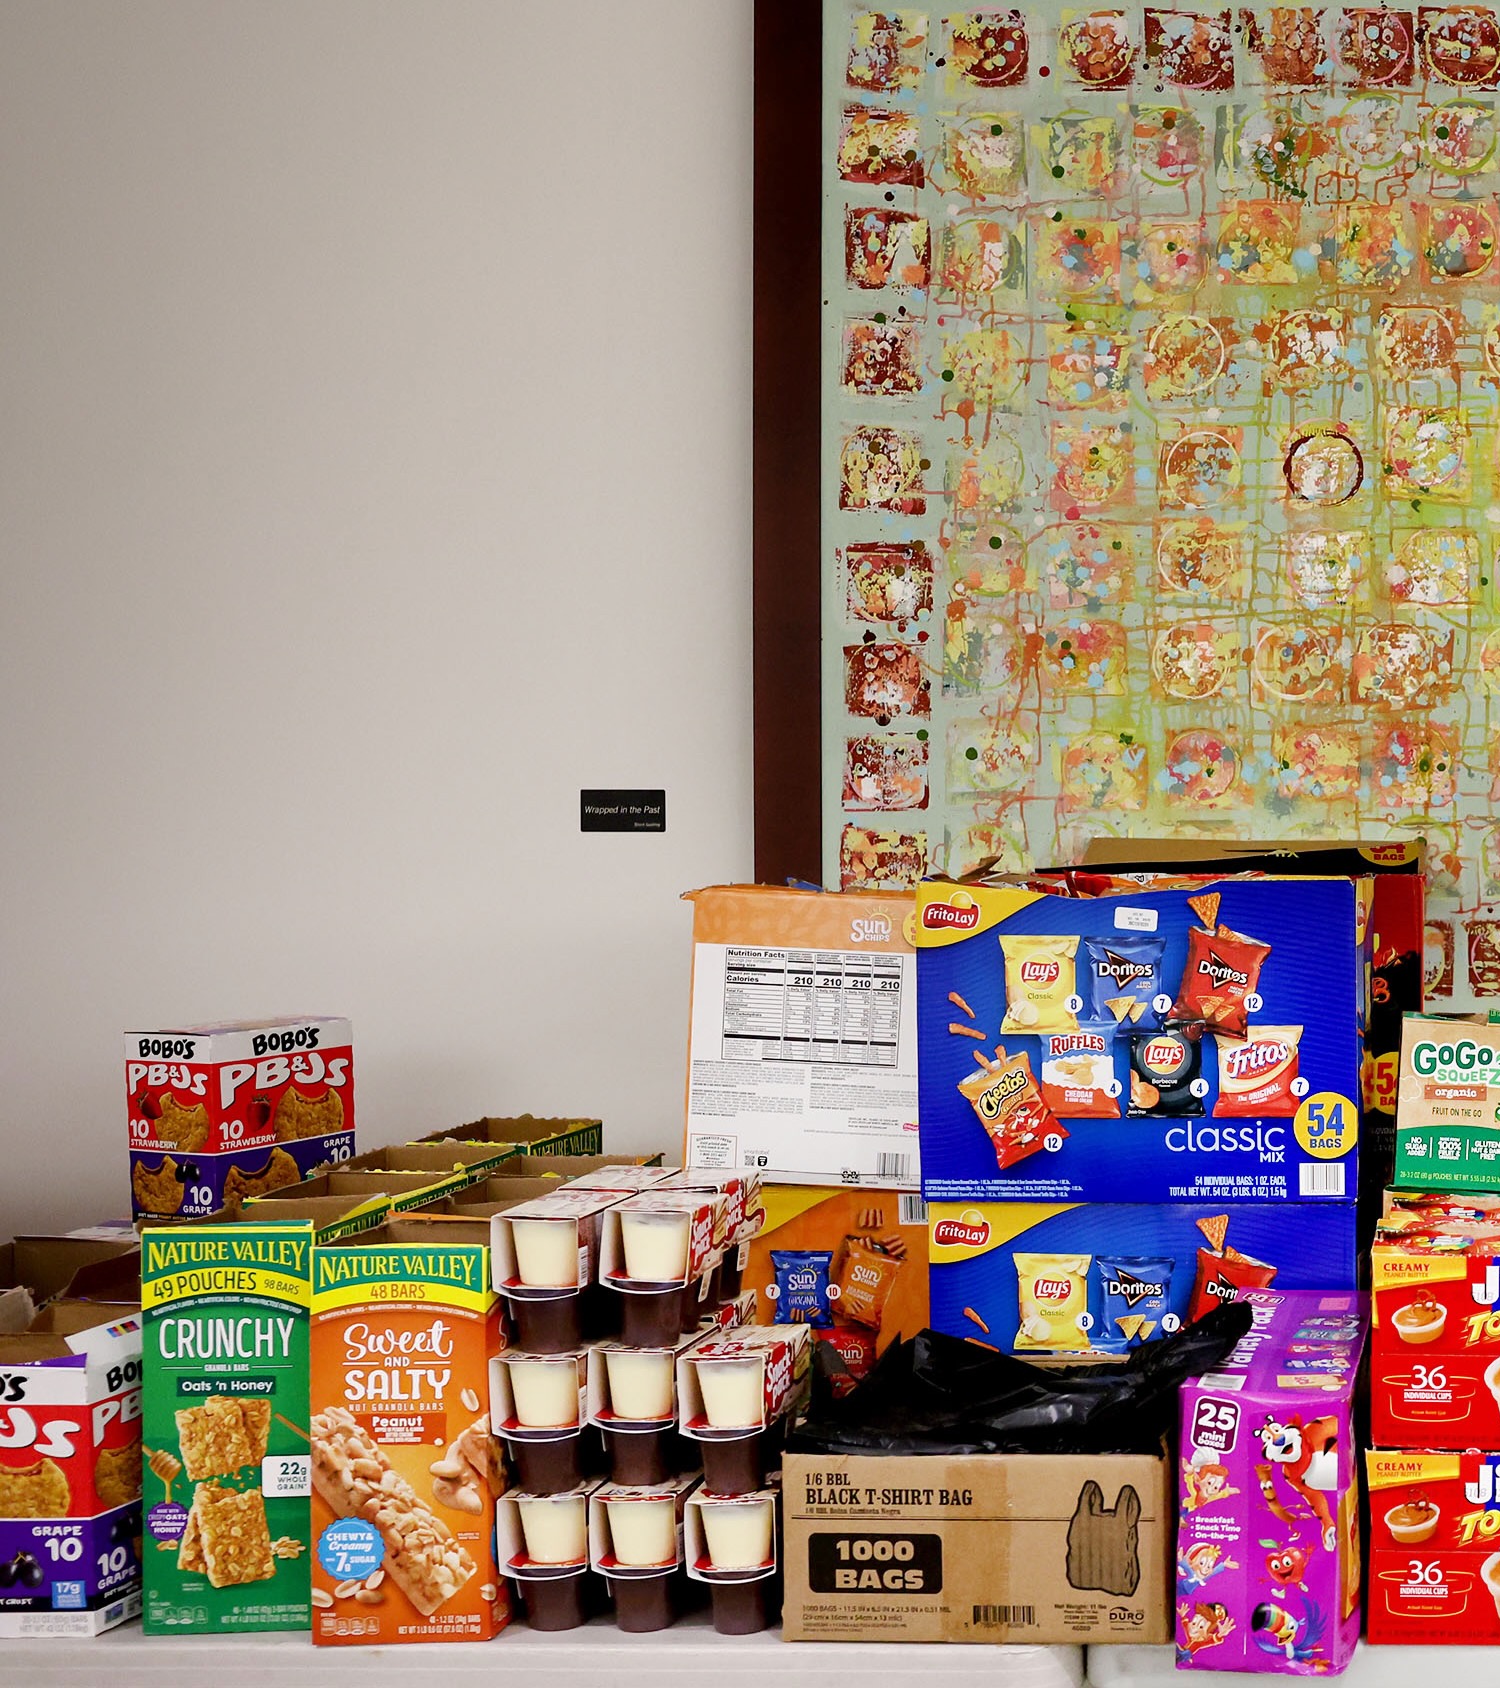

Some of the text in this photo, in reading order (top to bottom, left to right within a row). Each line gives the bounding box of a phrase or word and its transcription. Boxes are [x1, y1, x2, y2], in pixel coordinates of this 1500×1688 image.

[585, 806, 660, 815] Wrapped in the Past
[1200, 960, 1248, 986] Doritos
[794, 976, 900, 989] 210 210 210 210
[1028, 992, 1054, 1000] Classic
[1248, 998, 1258, 1008] 12
[139, 1038, 196, 1059] BOBO'S
[252, 1027, 320, 1056] BOBO'S
[1050, 1034, 1105, 1055] RUFFLES
[1435, 1087, 1478, 1099] organic
[1308, 1103, 1344, 1136] 54
[130, 1120, 149, 1138] 10
[219, 1120, 244, 1140] 10
[1164, 1120, 1286, 1152] classic
[324, 1136, 350, 1148] GRAPE
[1047, 1138, 1058, 1149] 12
[1310, 1139, 1342, 1149] BAGS
[1260, 1152, 1285, 1162] MIX
[190, 1186, 212, 1206] 10
[148, 1240, 306, 1273] NATURE VALLEY
[320, 1255, 478, 1288] NATURE VALLEY
[1384, 1263, 1430, 1272] CREAMY
[154, 1270, 300, 1299] 49 POUCHES 98 BARS
[370, 1284, 426, 1298] 48 BARS
[1110, 1280, 1162, 1297] Doritos
[1040, 1309, 1065, 1317] Classic
[159, 1318, 295, 1359] CRUNCHY
[343, 1320, 454, 1360] Sweet
[384, 1356, 410, 1367] AND
[344, 1370, 452, 1400] SALTY
[1411, 1365, 1446, 1390] 36
[372, 1416, 422, 1427] Peanut
[1198, 1403, 1235, 1430] 25
[1200, 1431, 1225, 1443] mini
[1376, 1462, 1423, 1471] CREAMY
[805, 1473, 850, 1485] 1/6 BBL
[806, 1488, 973, 1506] BLACK T-SHIRT BAG
[32, 1526, 83, 1536] GRAPE
[45, 1537, 83, 1562] 10
[836, 1540, 914, 1561] 1000
[97, 1546, 127, 1578] 10
[835, 1569, 924, 1590] BAGS
[1407, 1560, 1443, 1585] 36
[1109, 1612, 1144, 1620] DURO
